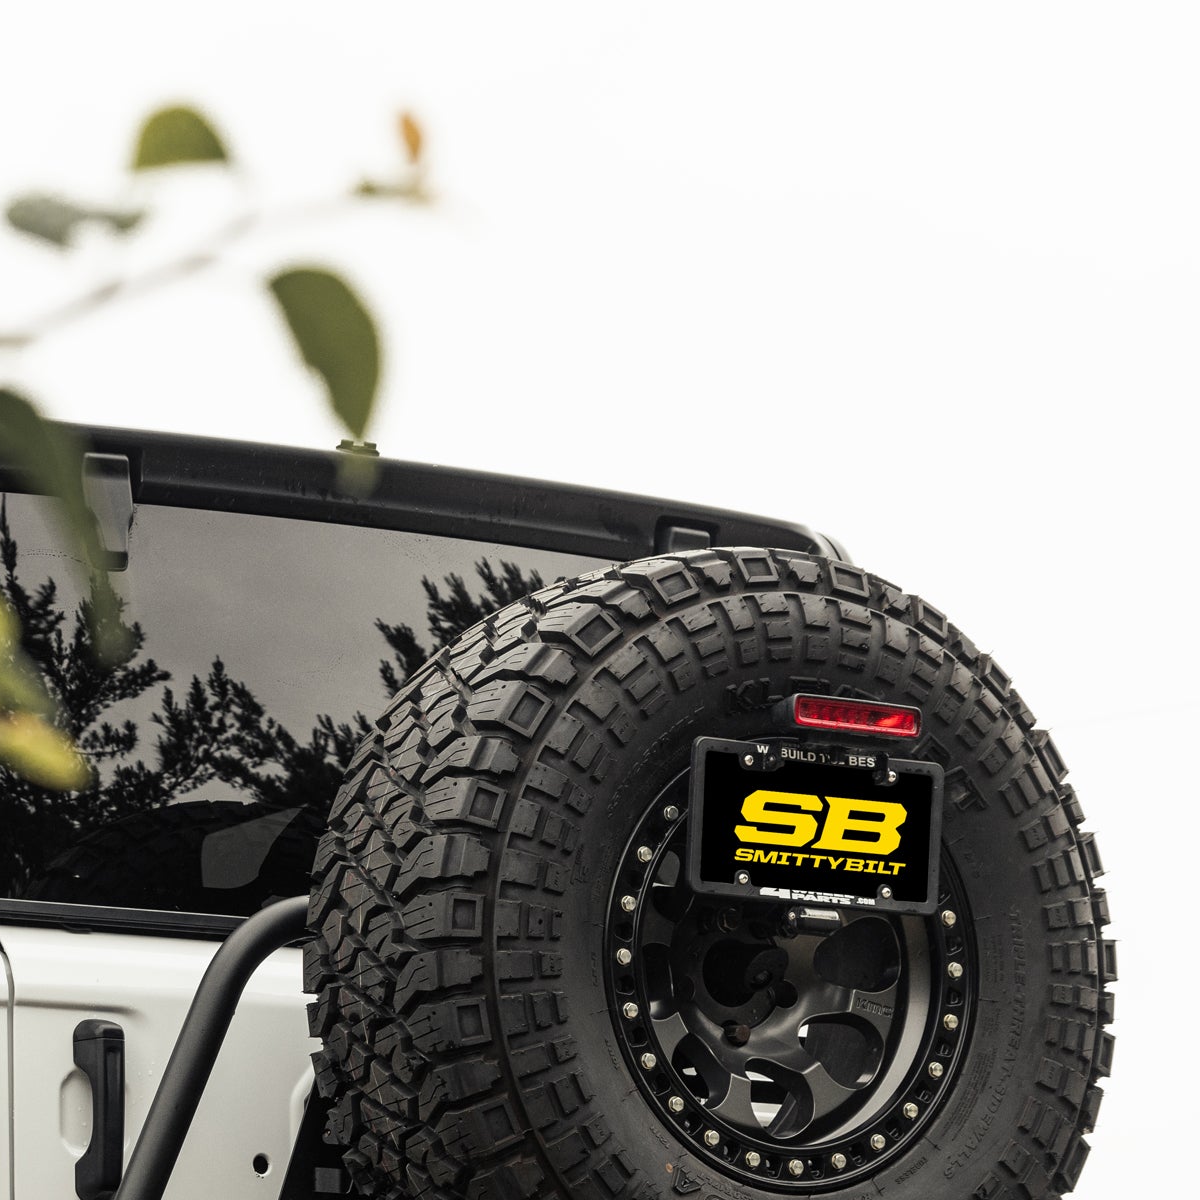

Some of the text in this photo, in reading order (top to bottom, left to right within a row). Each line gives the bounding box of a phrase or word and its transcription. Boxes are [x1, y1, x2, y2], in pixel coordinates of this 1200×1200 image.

[781, 748, 816, 762] BUILD
[849, 756, 877, 768] BES
[734, 789, 908, 855] SB
[734, 848, 906, 875] SMITTYBILT
